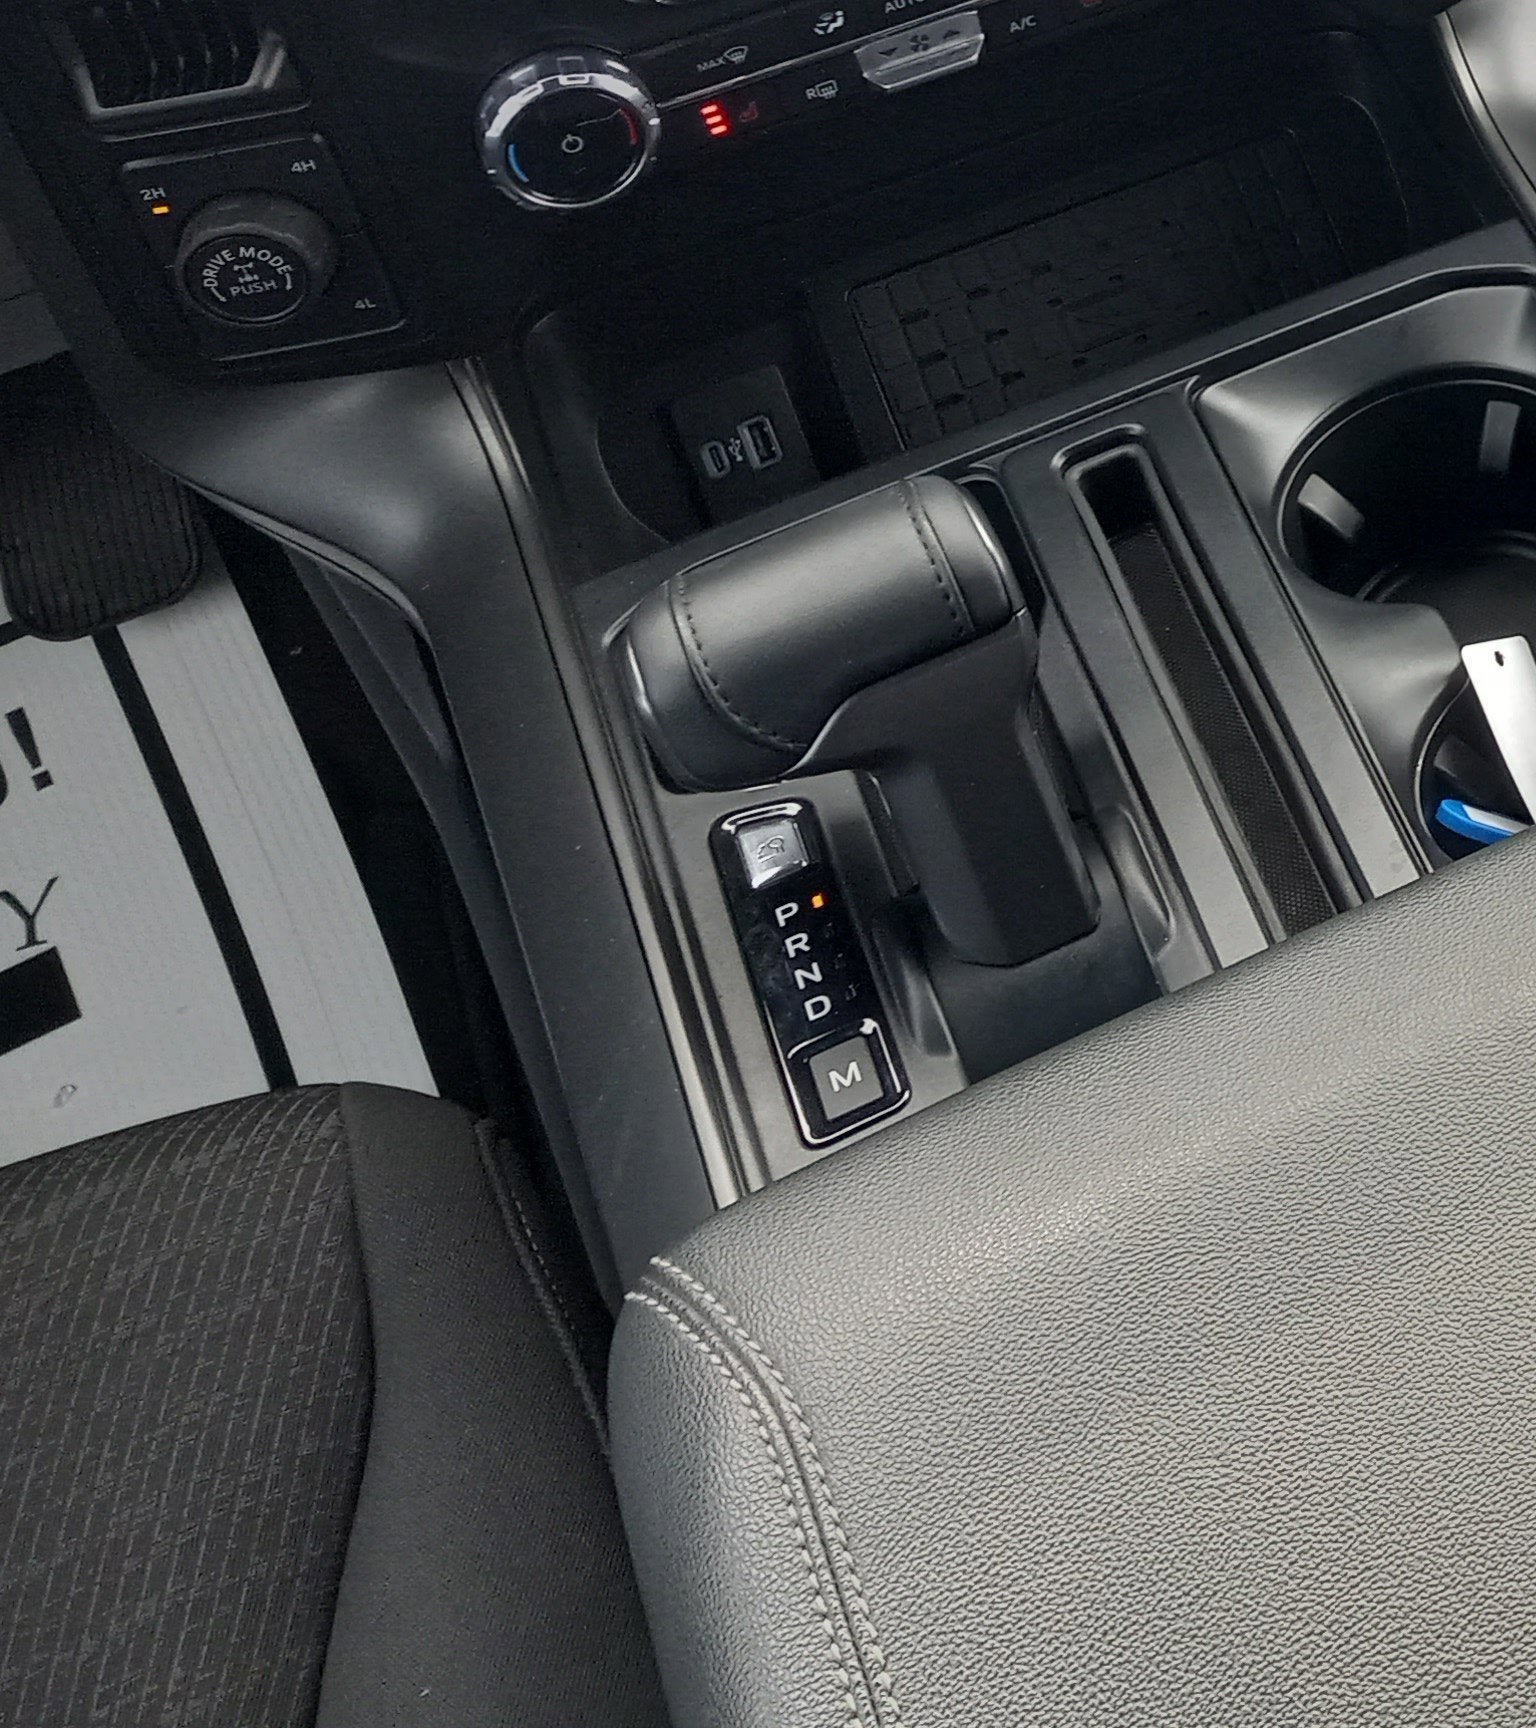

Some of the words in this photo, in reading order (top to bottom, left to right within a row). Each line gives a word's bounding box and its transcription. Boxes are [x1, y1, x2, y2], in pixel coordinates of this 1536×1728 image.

[1009, 14, 1038, 34] A/C
[290, 158, 317, 174] 4H
[139, 186, 167, 202] 2H
[203, 248, 236, 289] DRIVE
[238, 246, 294, 276] MODE
[229, 277, 279, 298] PUSH
[353, 297, 377, 311] 4L
[774, 901, 799, 928] P
[784, 932, 811, 958] R
[793, 961, 822, 990] N
[803, 993, 833, 1023] D
[826, 1060, 863, 1094] M
